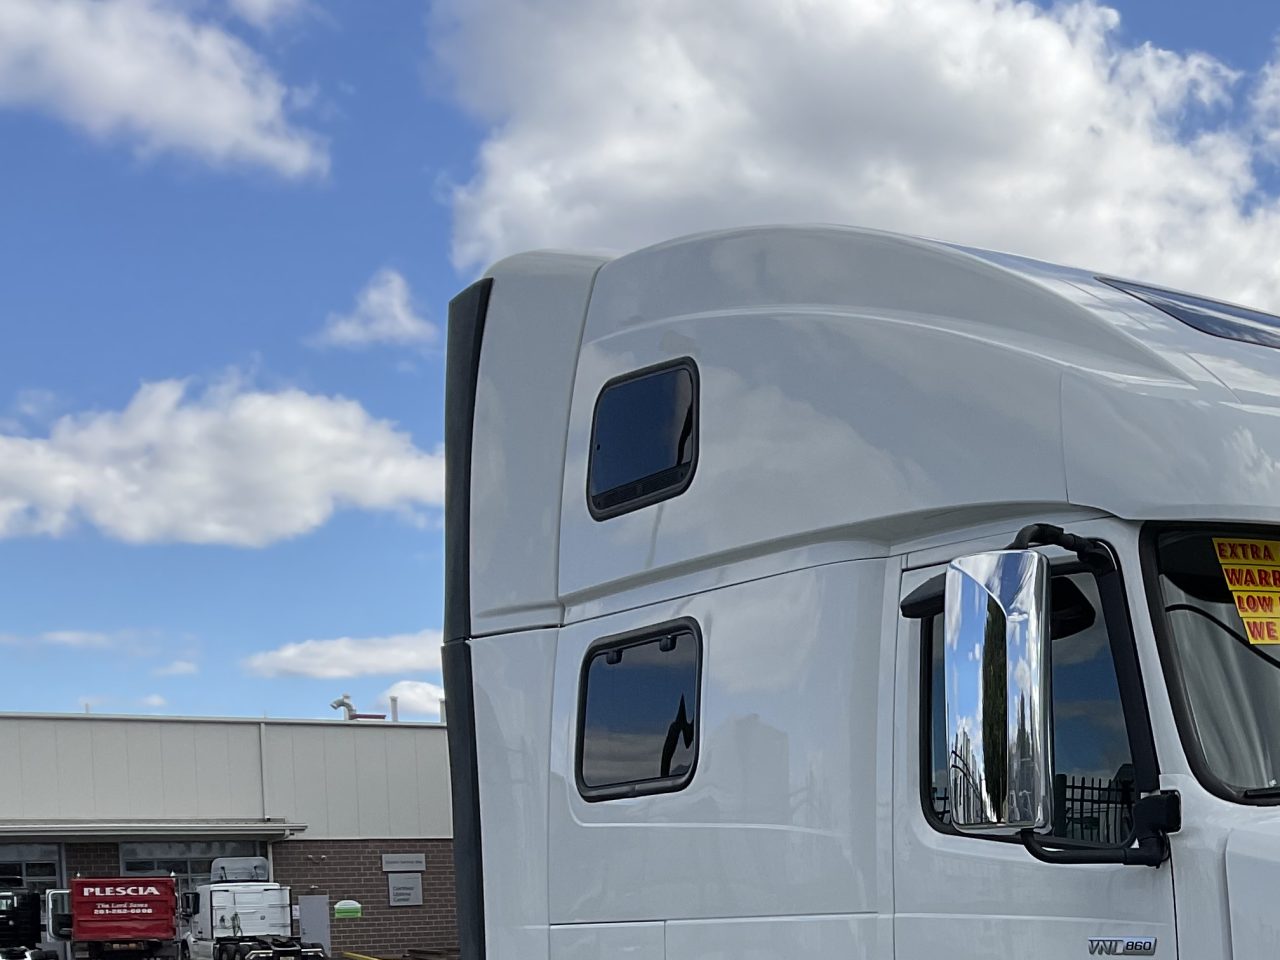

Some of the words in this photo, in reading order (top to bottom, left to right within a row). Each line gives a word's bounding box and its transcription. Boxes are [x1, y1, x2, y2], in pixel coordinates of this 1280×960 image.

[1217, 542, 1274, 561] EXTRA
[1236, 595, 1273, 613] LOW
[1246, 621, 1278, 641] WE
[83, 886, 160, 896] PLESCIA
[1125, 941, 1152, 951] 860
